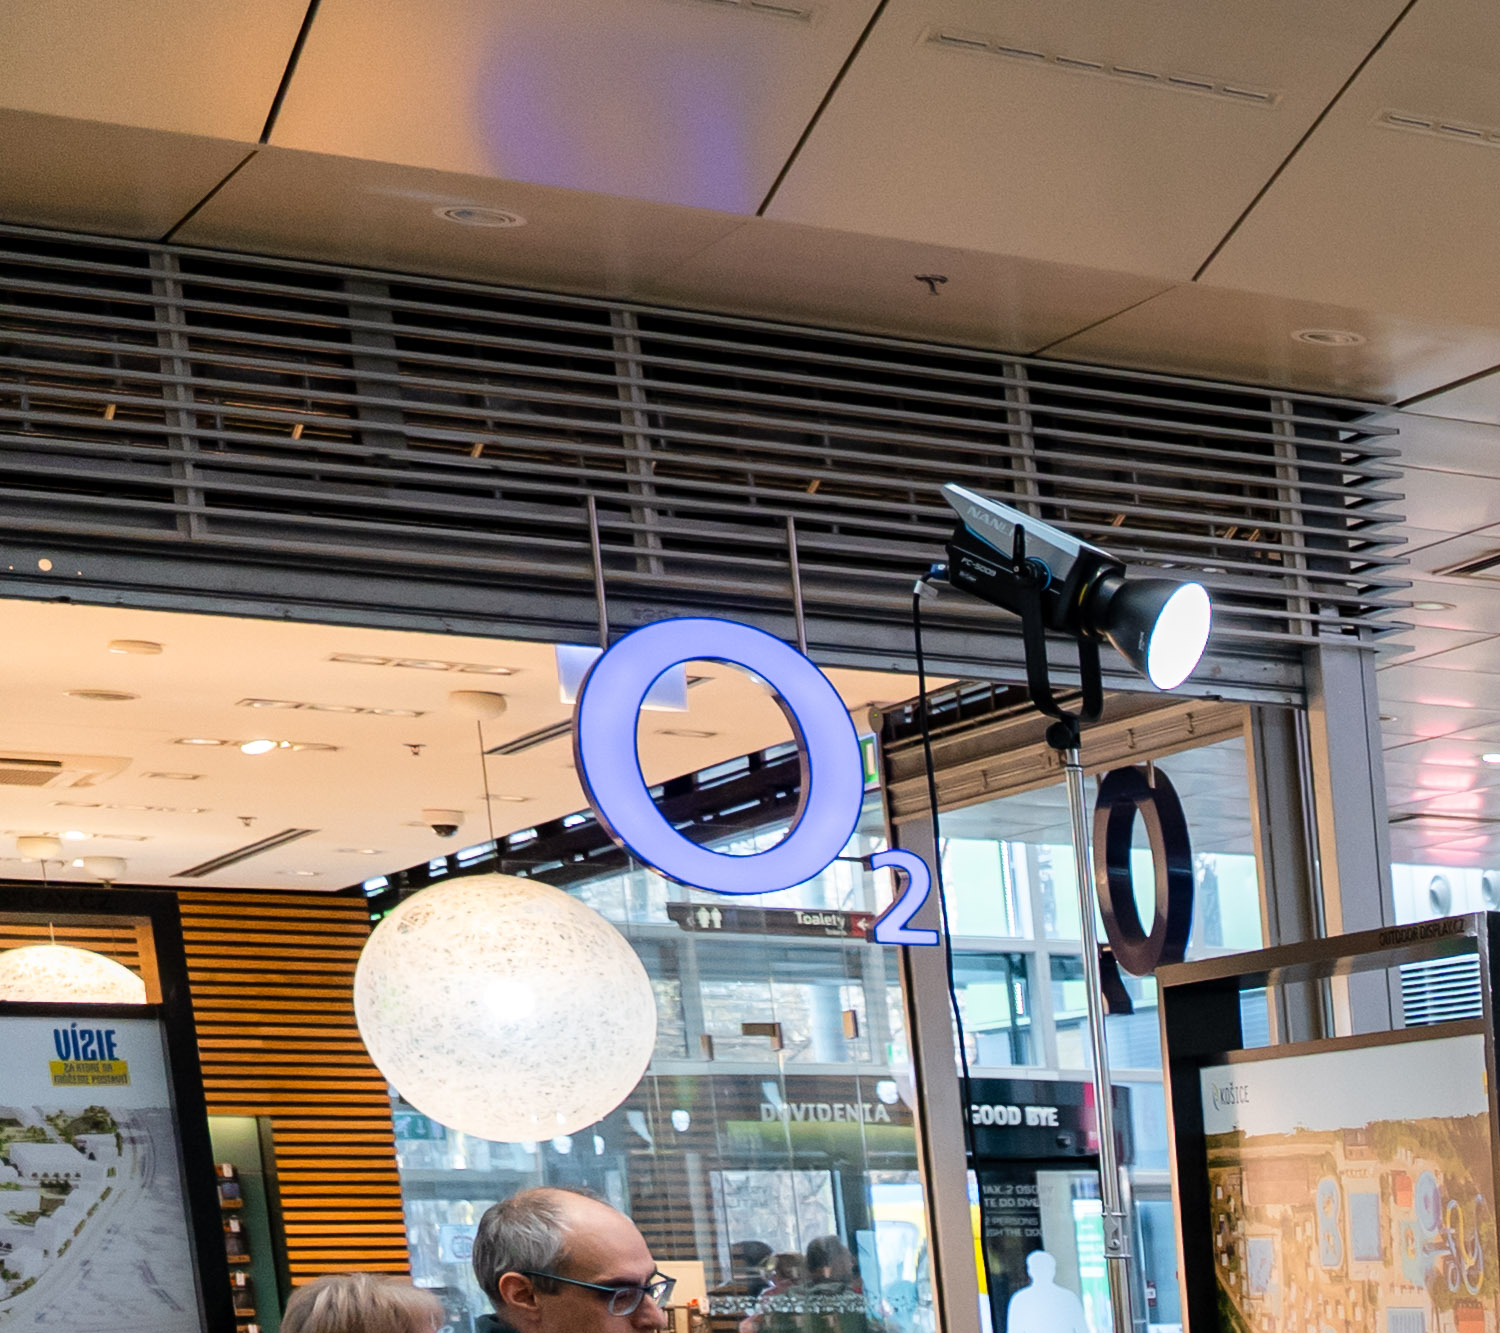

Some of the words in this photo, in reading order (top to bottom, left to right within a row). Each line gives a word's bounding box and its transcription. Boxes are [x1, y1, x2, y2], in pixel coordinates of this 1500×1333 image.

[794, 910, 846, 930] Toalety
[1219, 1082, 1250, 1105] KOŠICE
[760, 1102, 891, 1123] DOVIDENIA
[967, 1104, 1022, 1126] GOOD
[1025, 1106, 1059, 1127] BYE
